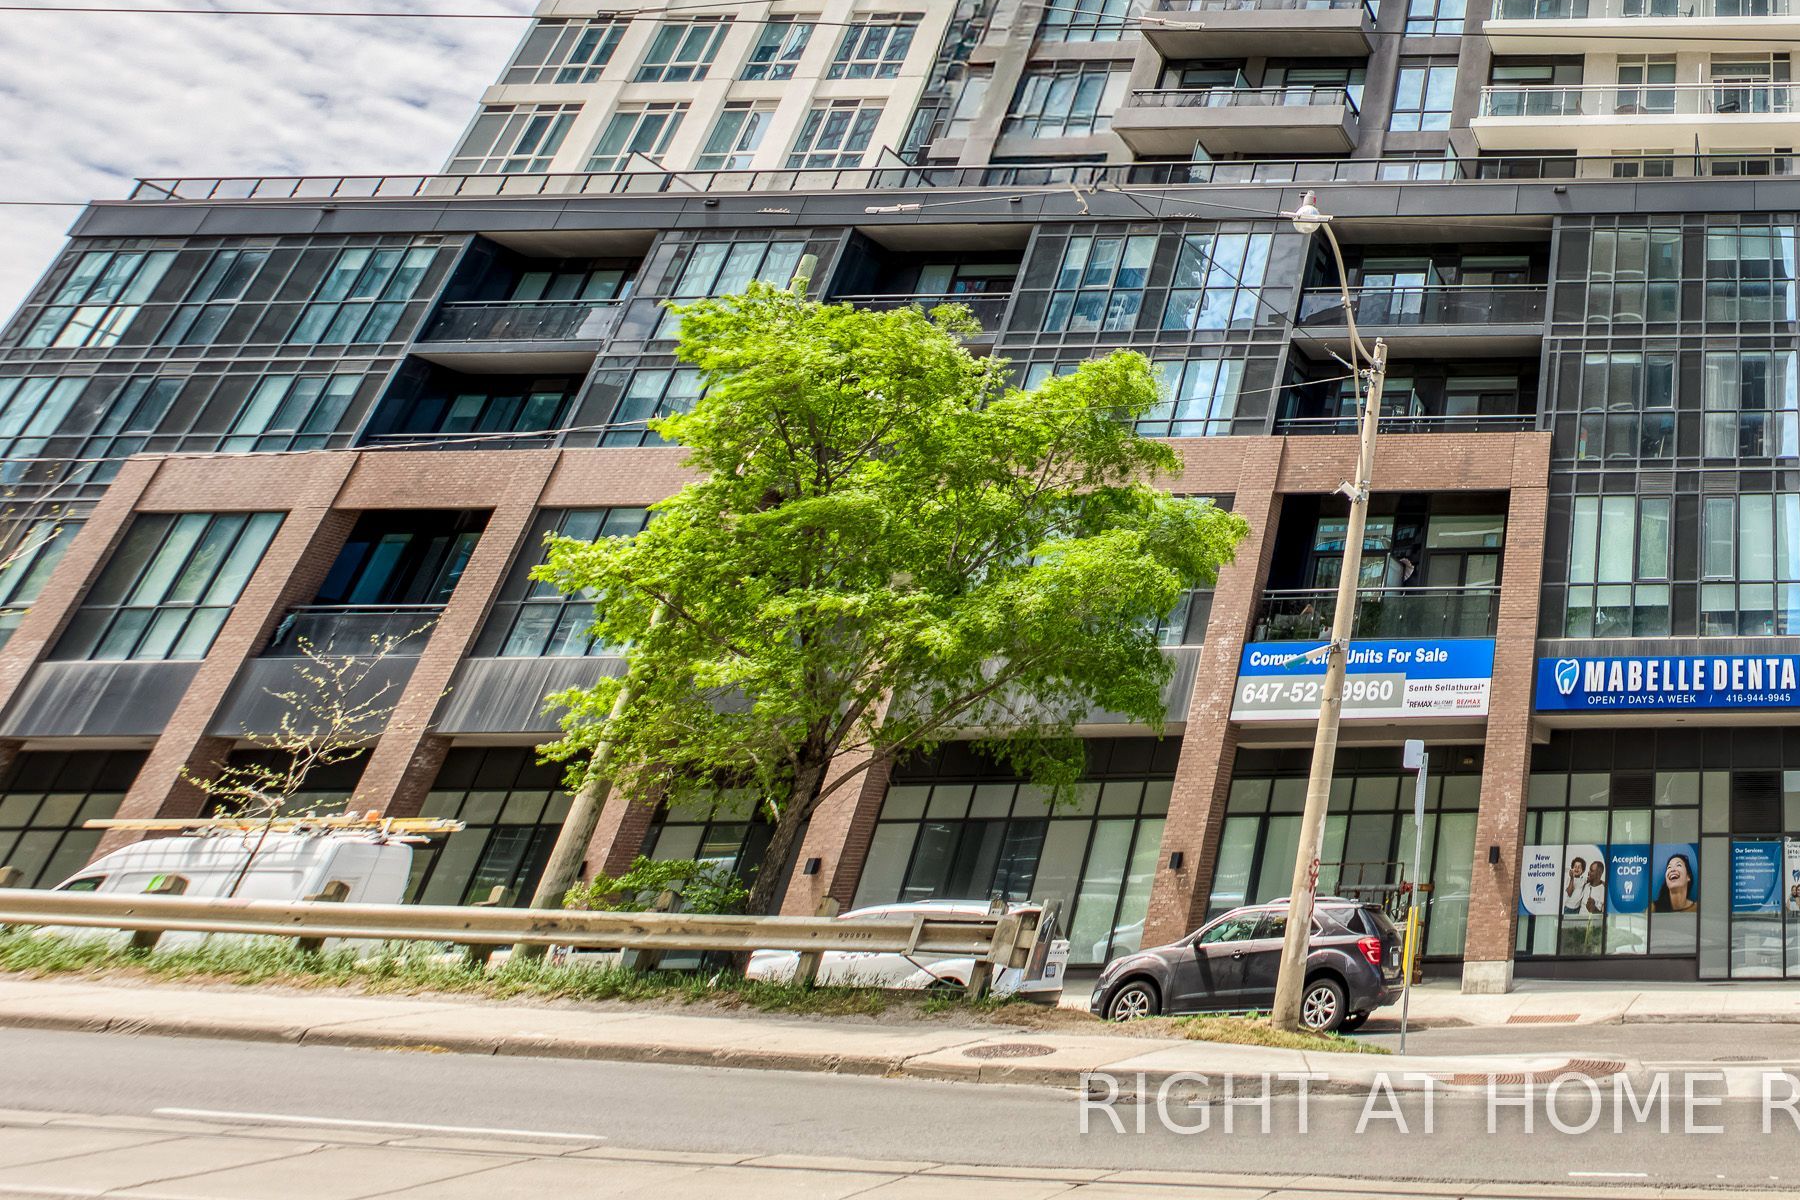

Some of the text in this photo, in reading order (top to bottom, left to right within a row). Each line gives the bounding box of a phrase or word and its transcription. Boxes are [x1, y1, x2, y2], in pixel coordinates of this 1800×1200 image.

[1347, 648, 1384, 664] Units
[1388, 648, 1412, 663] For
[1415, 647, 1448, 662] Sale
[1583, 658, 1705, 692] MABELLE
[1242, 680, 1393, 703] 647-529960
[1588, 696, 1616, 705] OPEN
[1619, 695, 1625, 704] 7
[1628, 695, 1655, 704] DAYS
[1657, 695, 1664, 704] A
[1667, 695, 1696, 703] WEEK
[1726, 693, 1791, 703] 416-944-9945
[1529, 861, 1555, 870] patients
[1612, 855, 1648, 865] Accepting
[1617, 866, 1642, 875] CDCP
